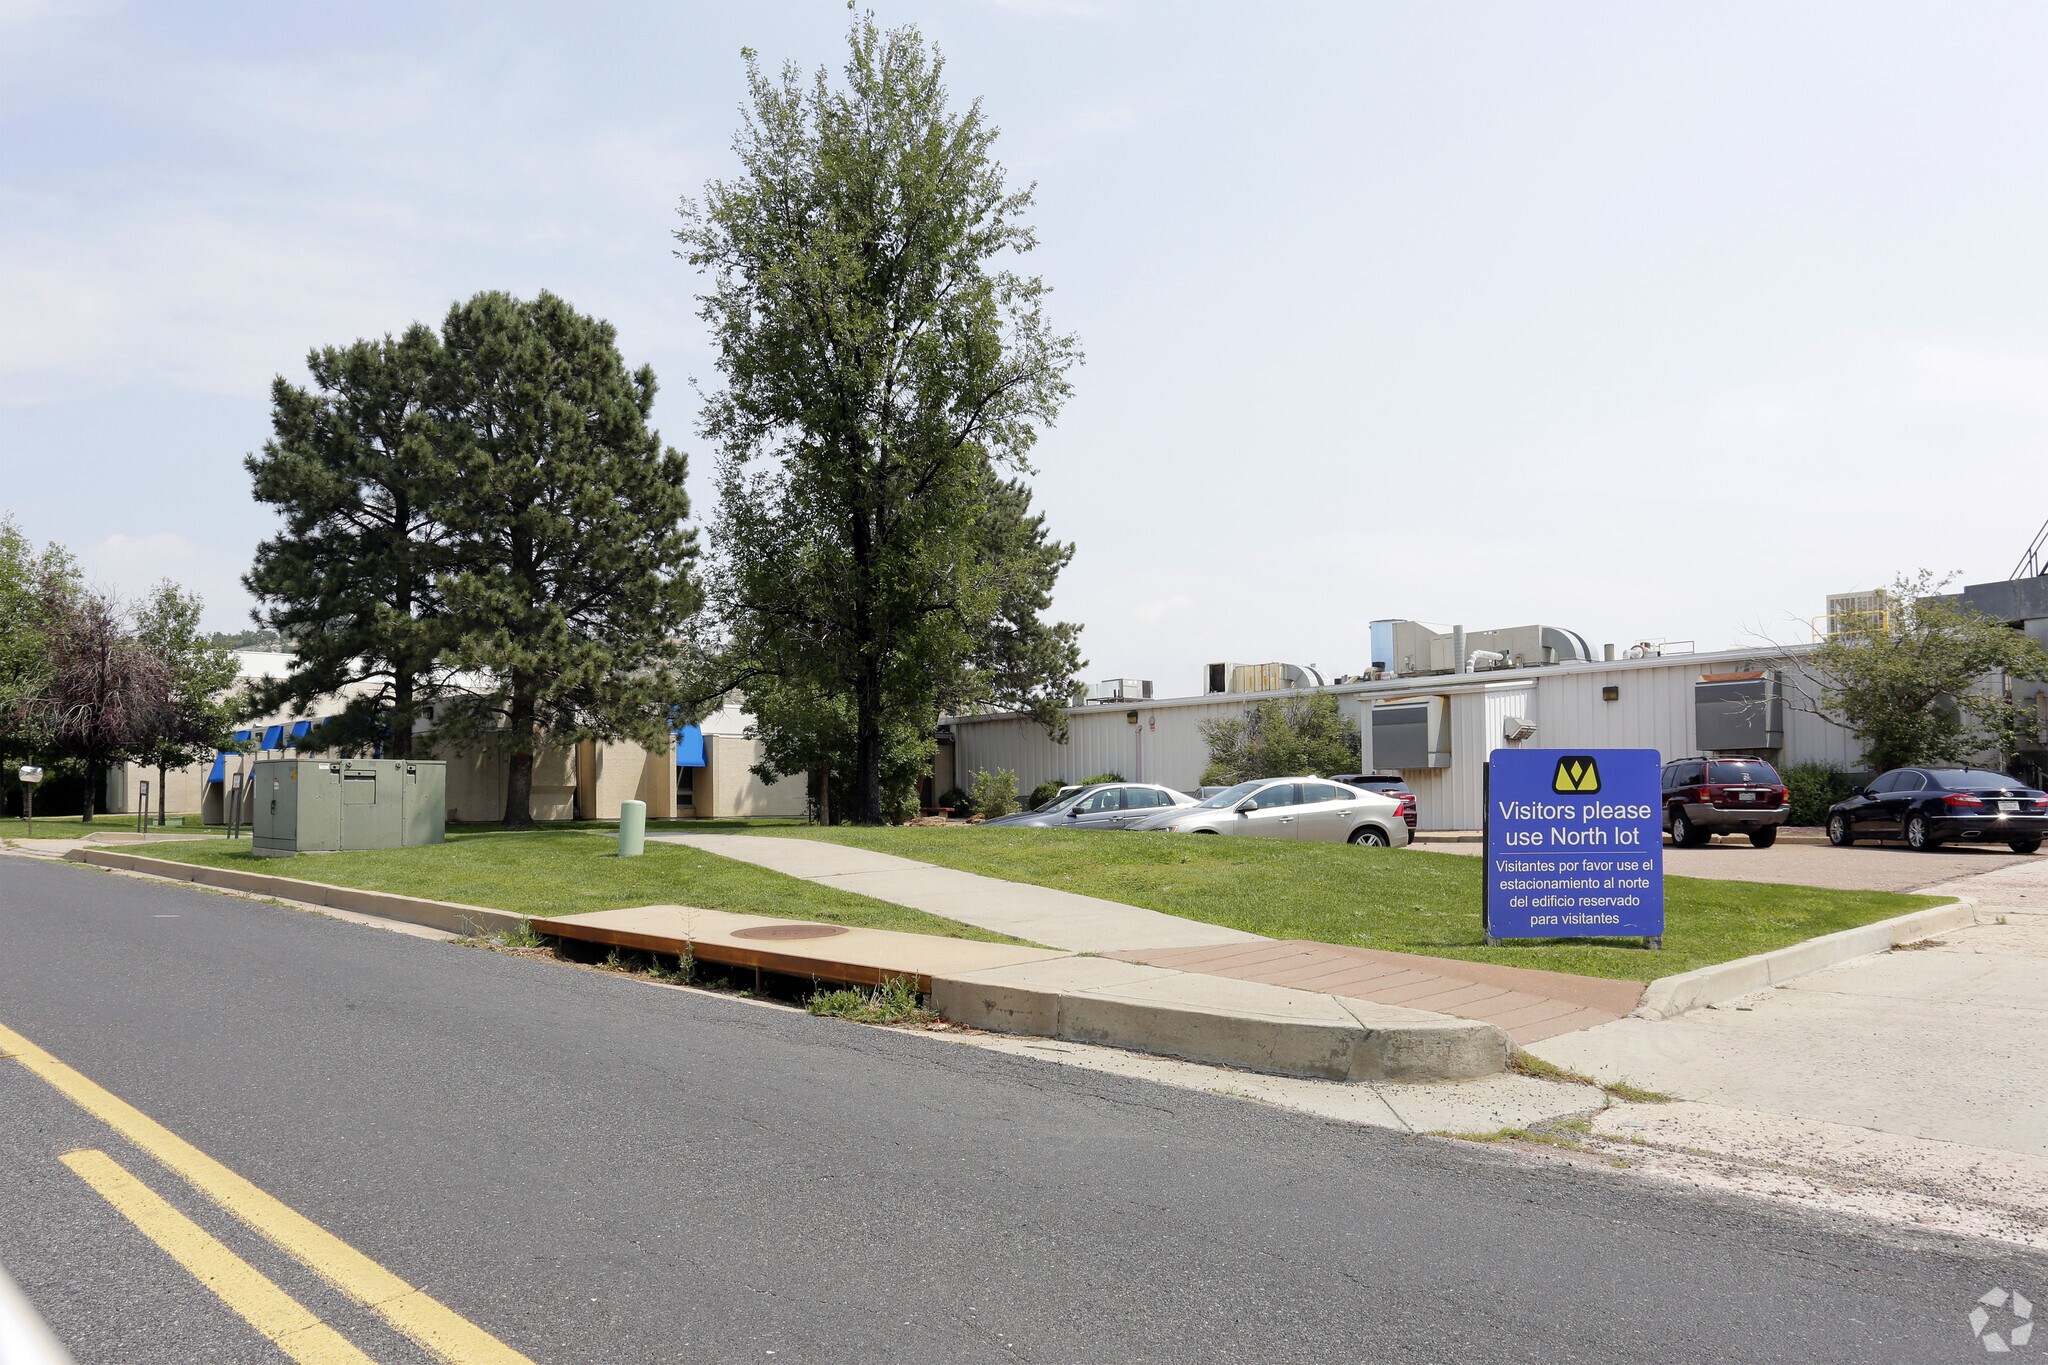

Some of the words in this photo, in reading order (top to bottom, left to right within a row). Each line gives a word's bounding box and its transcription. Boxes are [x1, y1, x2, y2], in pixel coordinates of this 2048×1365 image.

[1498, 801, 1576, 820] Visitors
[1582, 801, 1652, 824] please
[1506, 831, 1544, 847] use
[1551, 827, 1608, 846] North
[1615, 826, 1640, 845] lot
[1495, 860, 1556, 873] Visitantes
[1558, 862, 1580, 875] por
[1582, 859, 1614, 872] favor
[1616, 862, 1639, 871] use
[1642, 858, 1654, 871] el
[1499, 877, 1600, 890] estacionamiento
[1603, 876, 1615, 889] al
[1618, 877, 1650, 889] norte
[1509, 895, 1528, 908] del
[1531, 894, 1575, 908] edificio
[1578, 894, 1640, 907] reservado
[1530, 915, 1559, 928] para
[1561, 912, 1620, 925] visitantes
